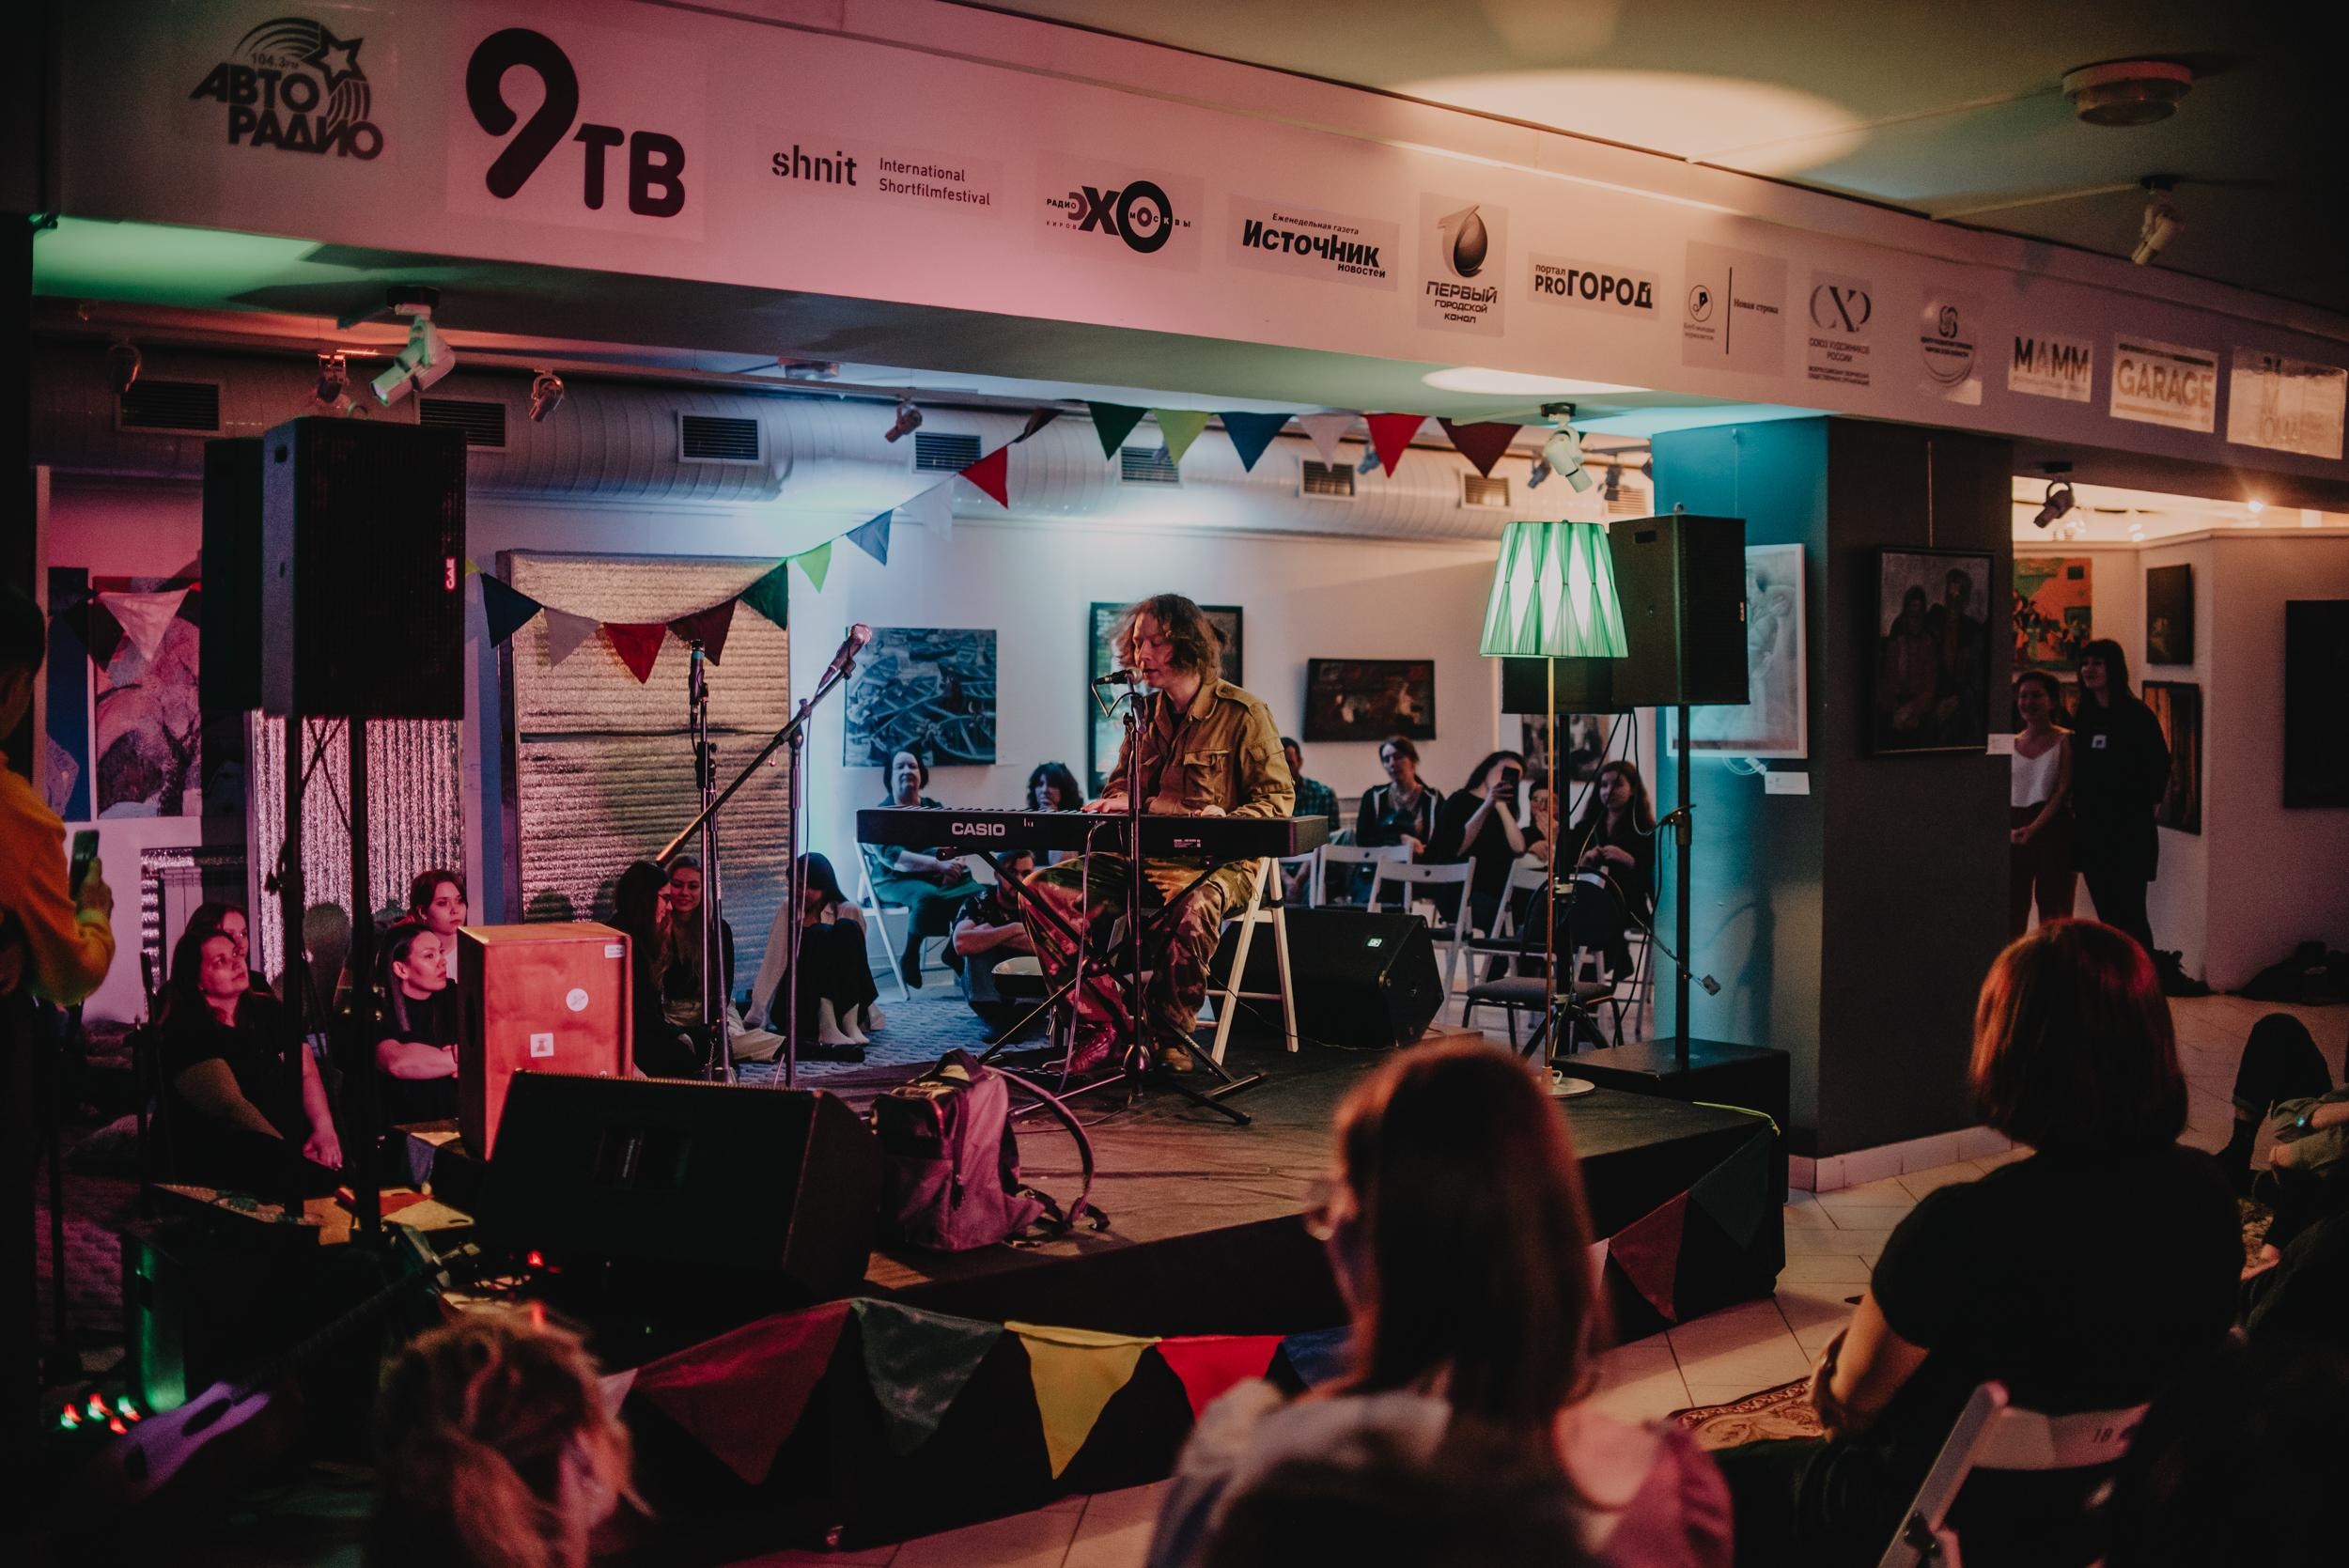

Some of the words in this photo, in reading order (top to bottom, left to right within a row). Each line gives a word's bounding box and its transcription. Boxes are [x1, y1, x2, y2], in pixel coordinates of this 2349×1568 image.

[189, 62, 320, 114] АВТО
[228, 105, 383, 161] РАДИО
[466, 27, 686, 218] 9ТВ
[771, 144, 857, 186] shnit
[879, 157, 965, 182] International
[879, 178, 990, 206] Shortfilmfestival
[1046, 198, 1077, 210] РАДИО
[1046, 221, 1077, 230] КИРОВ
[1067, 180, 1174, 254] ЭХО
[1272, 212, 1331, 230] Еженедельная
[1333, 225, 1359, 235] газета
[1535, 264, 1566, 275] портал
[1425, 280, 1498, 304] ПЕРВЫЙ
[2117, 359, 2214, 408] GARAGE
[951, 822, 1005, 836] CASIO
